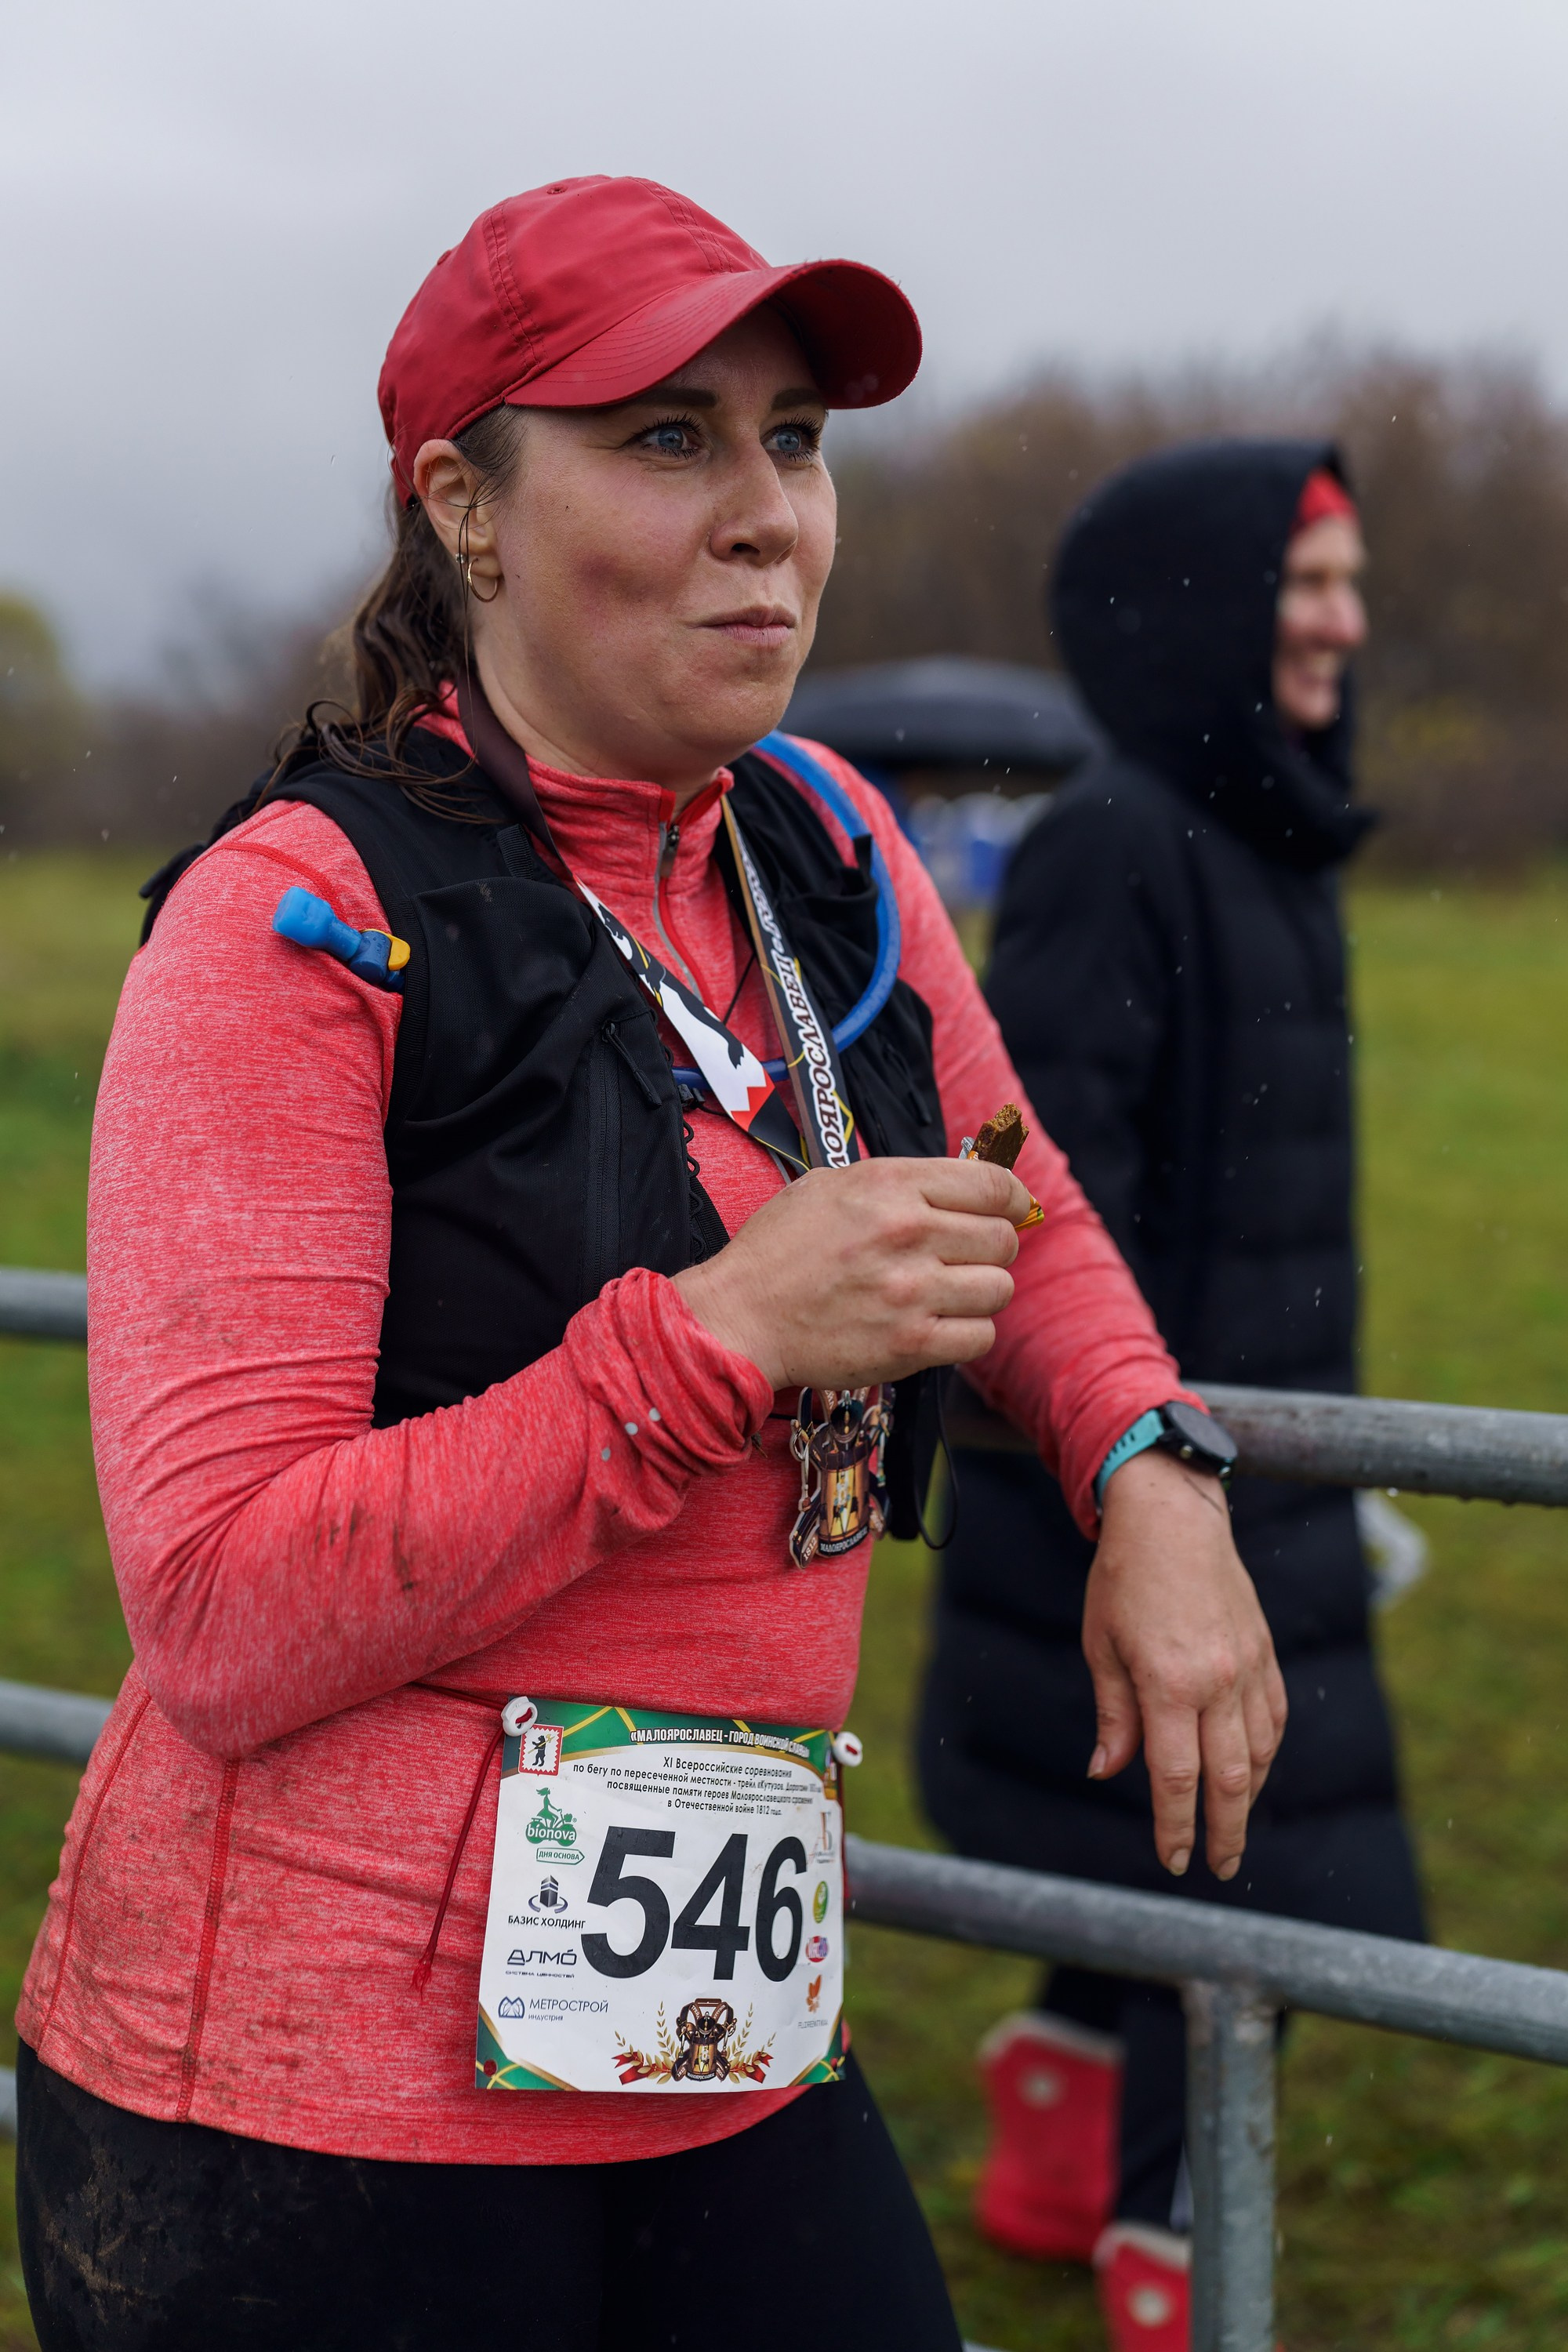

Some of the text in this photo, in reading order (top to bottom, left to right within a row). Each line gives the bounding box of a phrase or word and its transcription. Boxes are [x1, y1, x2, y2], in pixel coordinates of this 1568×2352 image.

[804, 1537, 816, 1561] 1812
[630, 1728, 723, 1743] «МАЛОЯРОСЛАВЕЦ
[728, 1730, 753, 1745] ГОРОД
[755, 1733, 789, 1751] ВОИНСКОЙ
[587, 1764, 608, 1777] бегу
[611, 1768, 622, 1777] по
[624, 1769, 688, 1783] пересеченной
[690, 1776, 731, 1787] местности
[738, 1779, 756, 1789] трейл
[663, 1757, 792, 1778] XI Всероссийские соревнования
[607, 1780, 670, 1795] посвященные
[673, 1786, 702, 1797] памяти
[704, 1789, 729, 1800] героев
[731, 1790, 791, 1804] Малоярославецкого
[674, 1798, 734, 1812] Отечественной
[735, 1803, 754, 1813] войне
[756, 1805, 770, 1815] 1812
[554, 1851, 580, 1860] ОСНОВА
[581, 1826, 808, 1982] 546
[508, 1915, 586, 1929] БАЗИС ХОЛДИНГ
[529, 1998, 609, 2013] МЕТРОСТРОЙ
